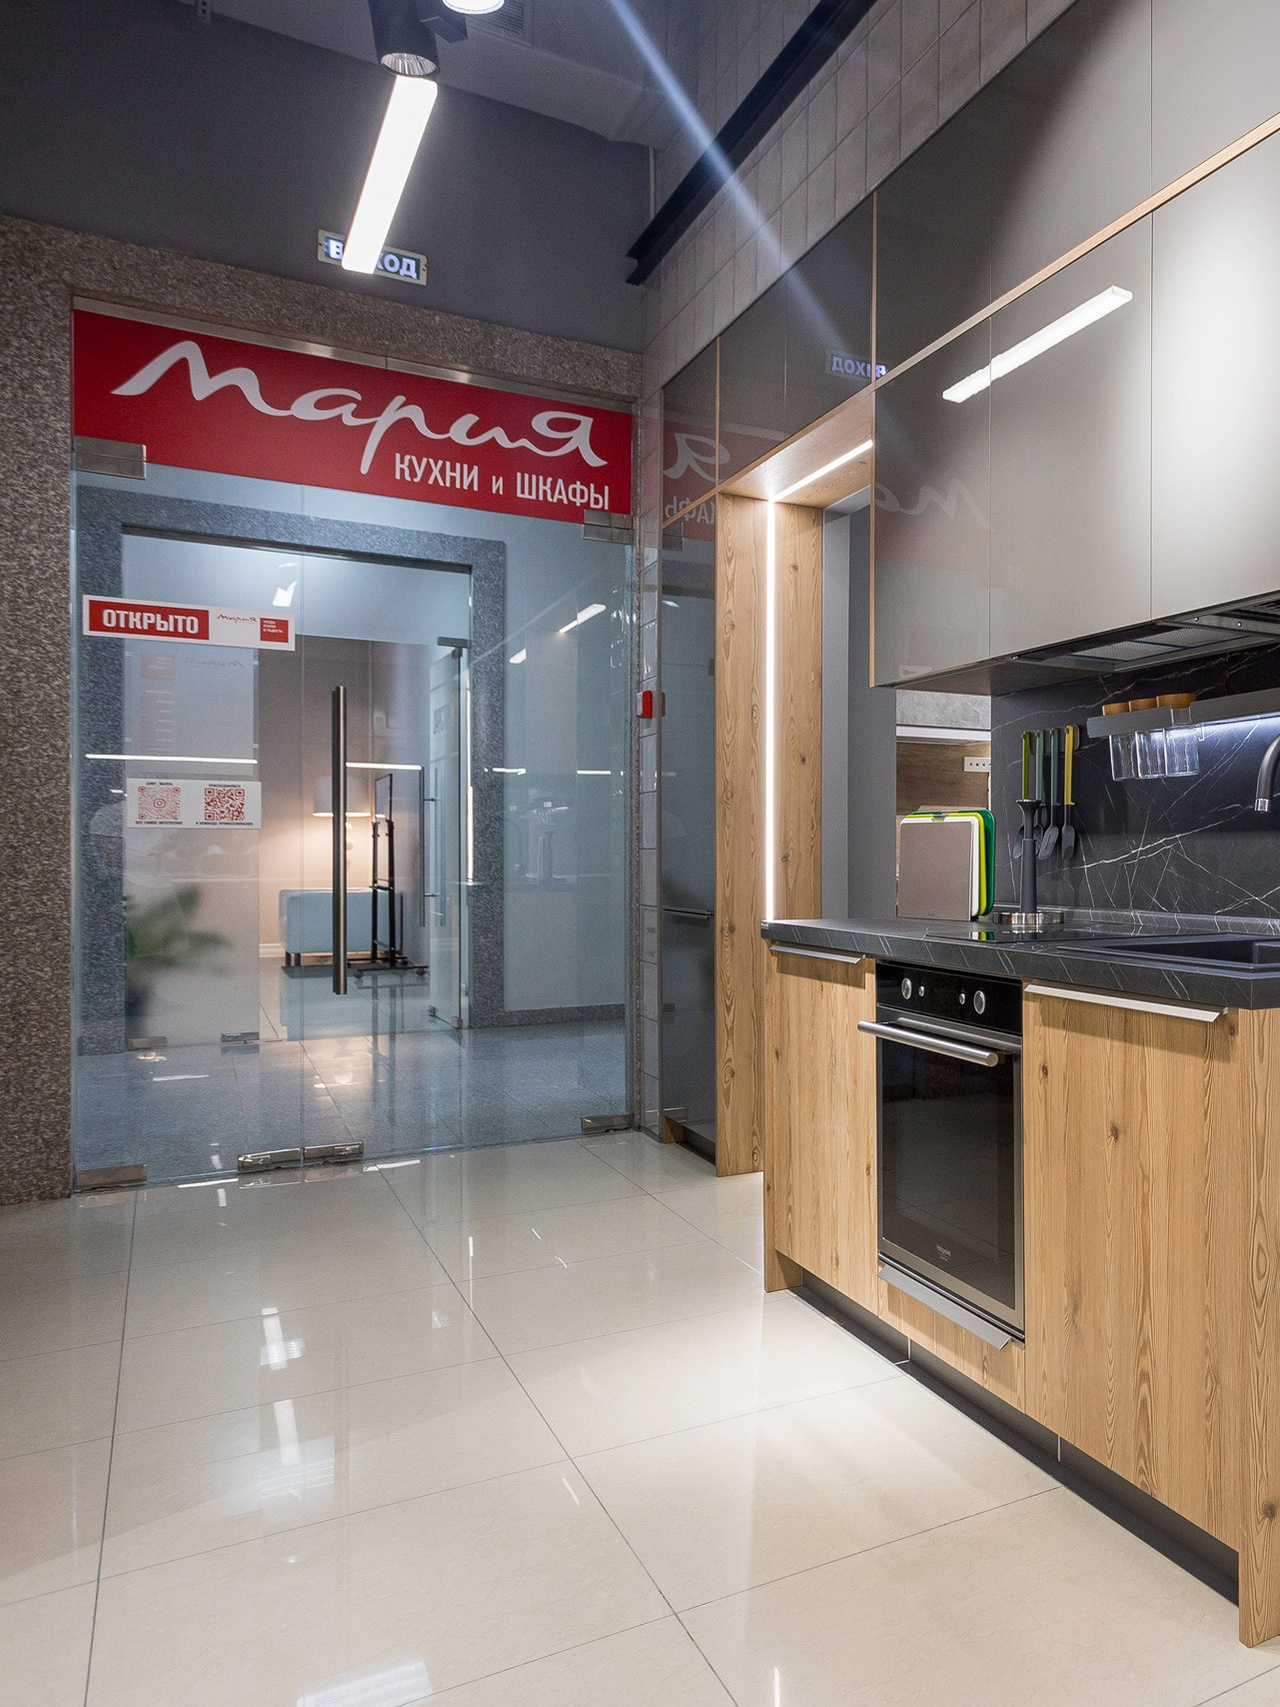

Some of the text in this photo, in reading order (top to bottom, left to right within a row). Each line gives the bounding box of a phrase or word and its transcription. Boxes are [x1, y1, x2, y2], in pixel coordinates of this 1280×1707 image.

[329, 239, 418, 279] ВОД
[395, 452, 610, 510] КУХНИ и ШКАФЫ
[102, 608, 199, 634] ОТКРЫТО
